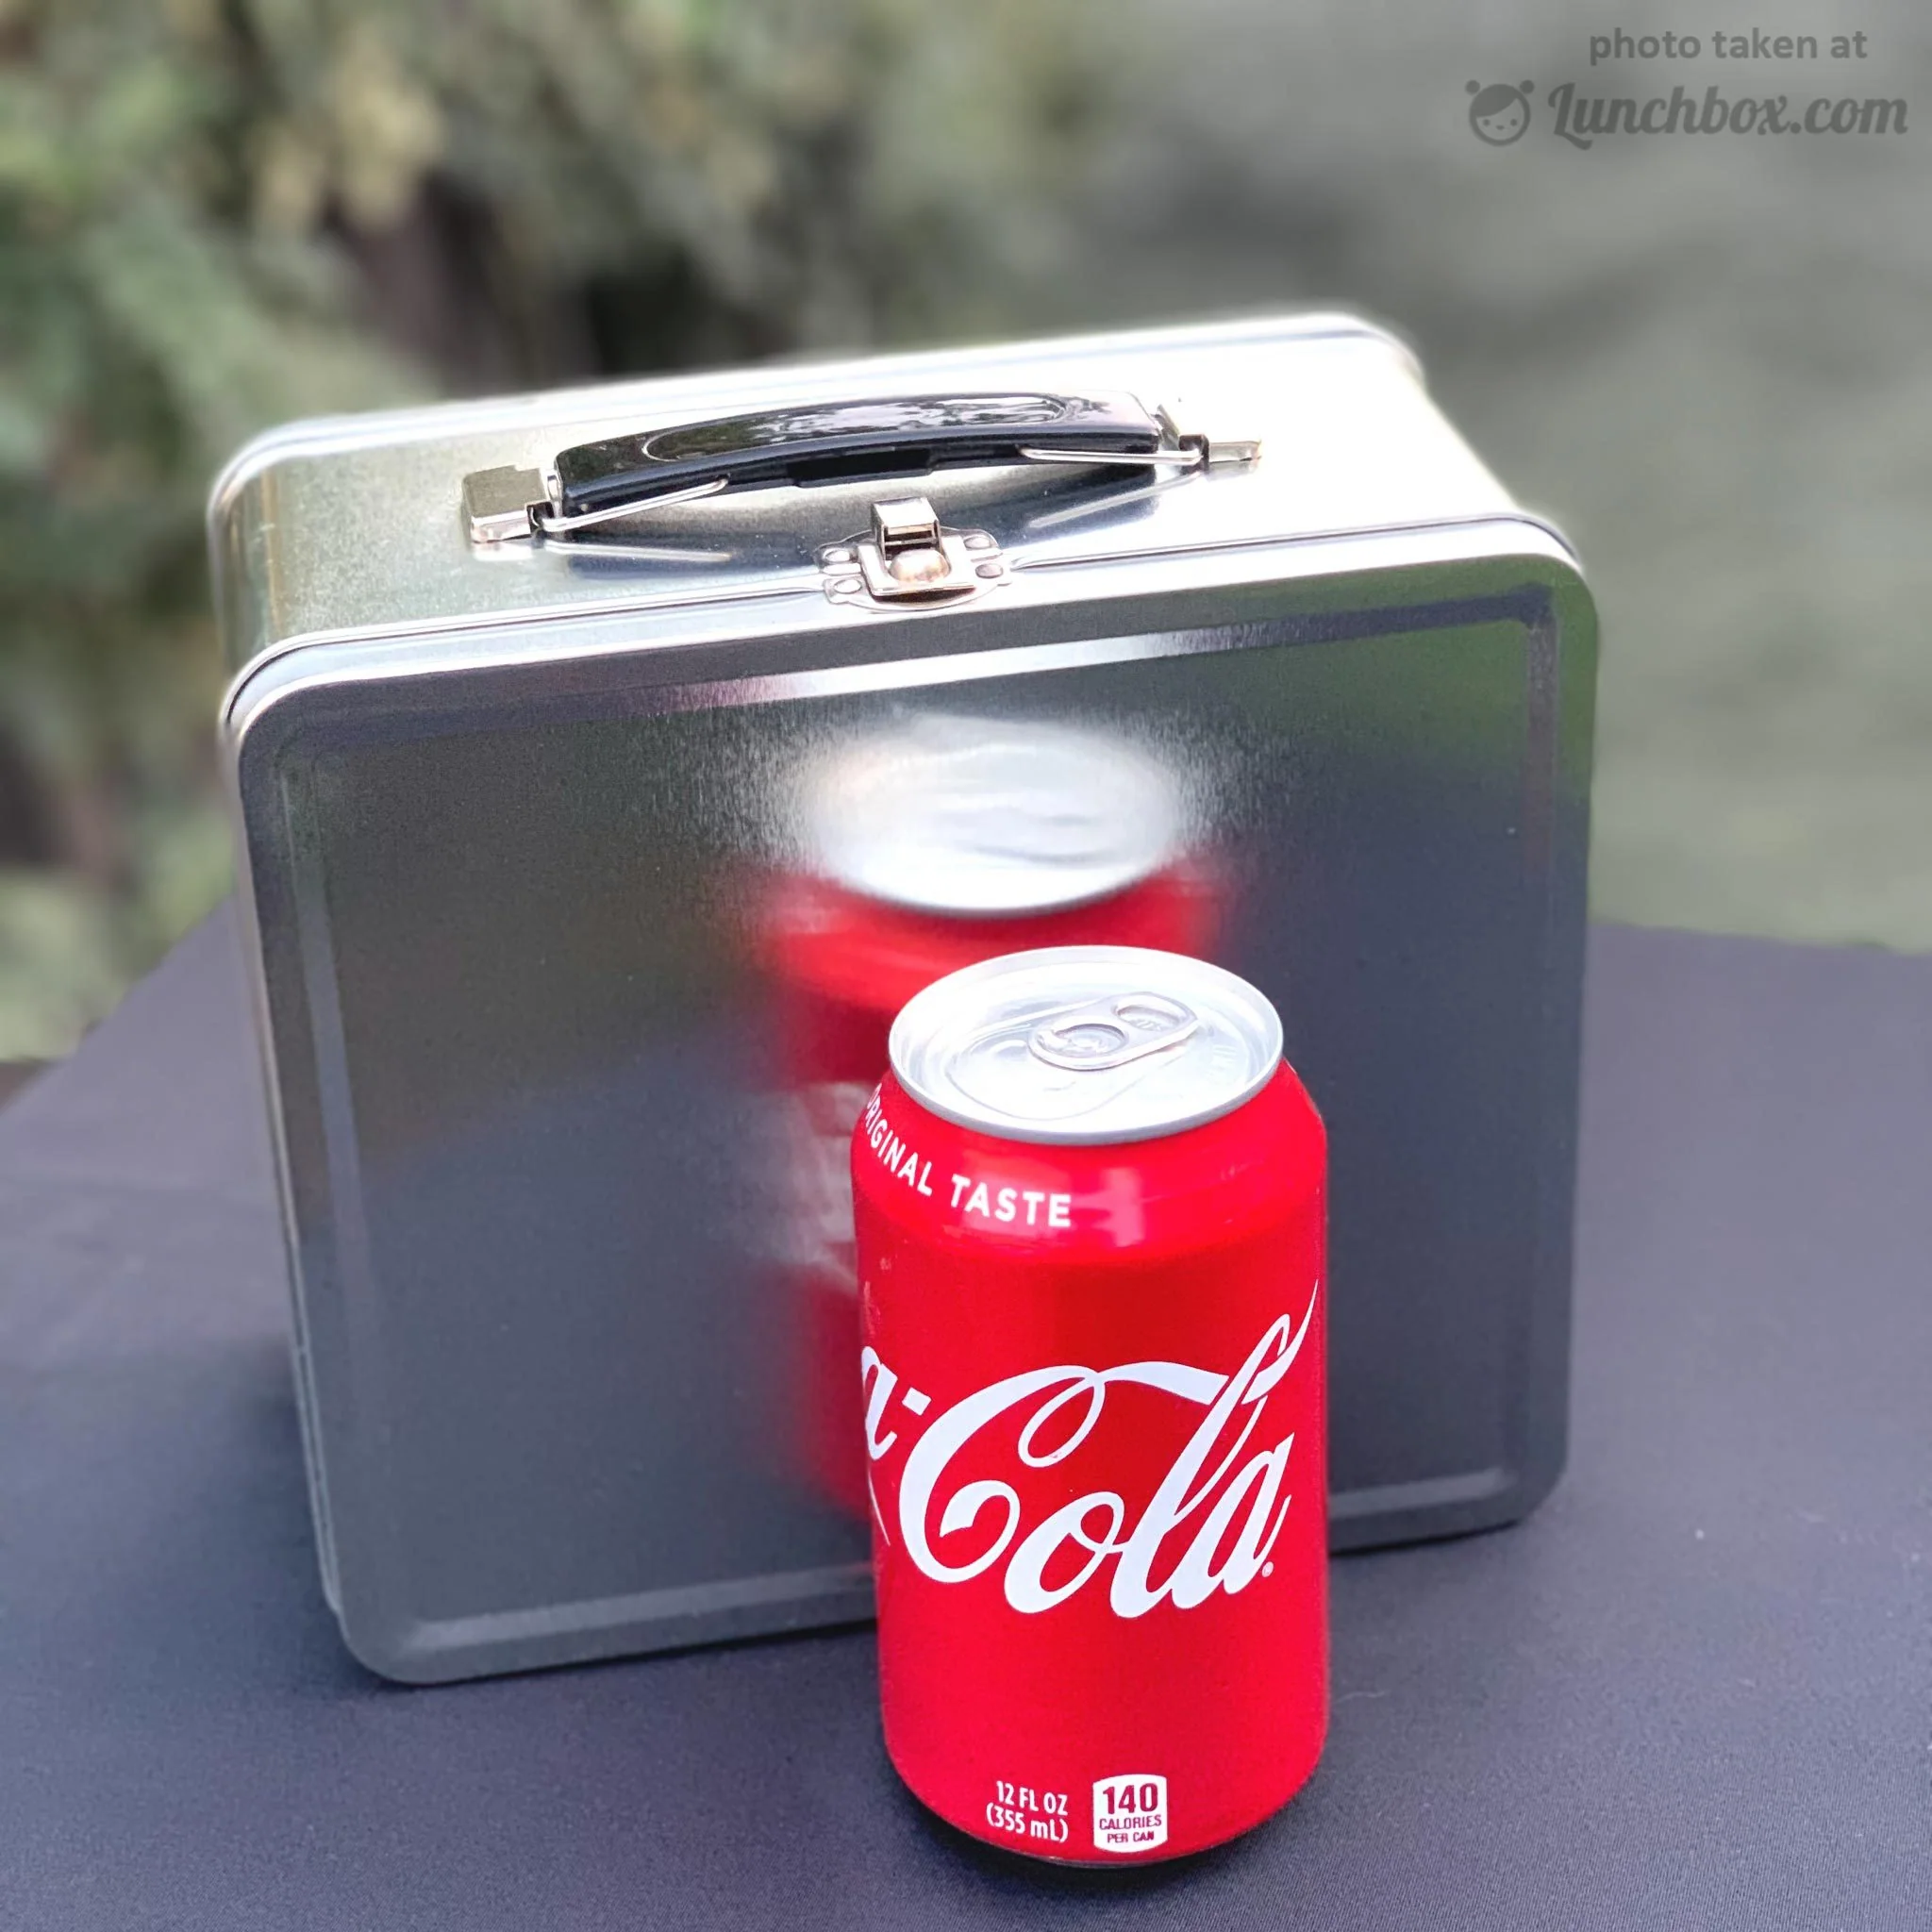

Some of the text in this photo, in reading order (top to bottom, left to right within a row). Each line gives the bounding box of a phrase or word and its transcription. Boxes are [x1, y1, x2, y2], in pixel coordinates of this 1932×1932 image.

[950, 1174, 1072, 1228] TASTE
[996, 1780, 1069, 1816] 12 FL OZ
[1102, 1782, 1158, 1815] 140
[986, 1802, 1069, 1842] (355 mL)
[1099, 1814, 1162, 1830] CALORIES
[1107, 1830, 1155, 1843] PER CAN
